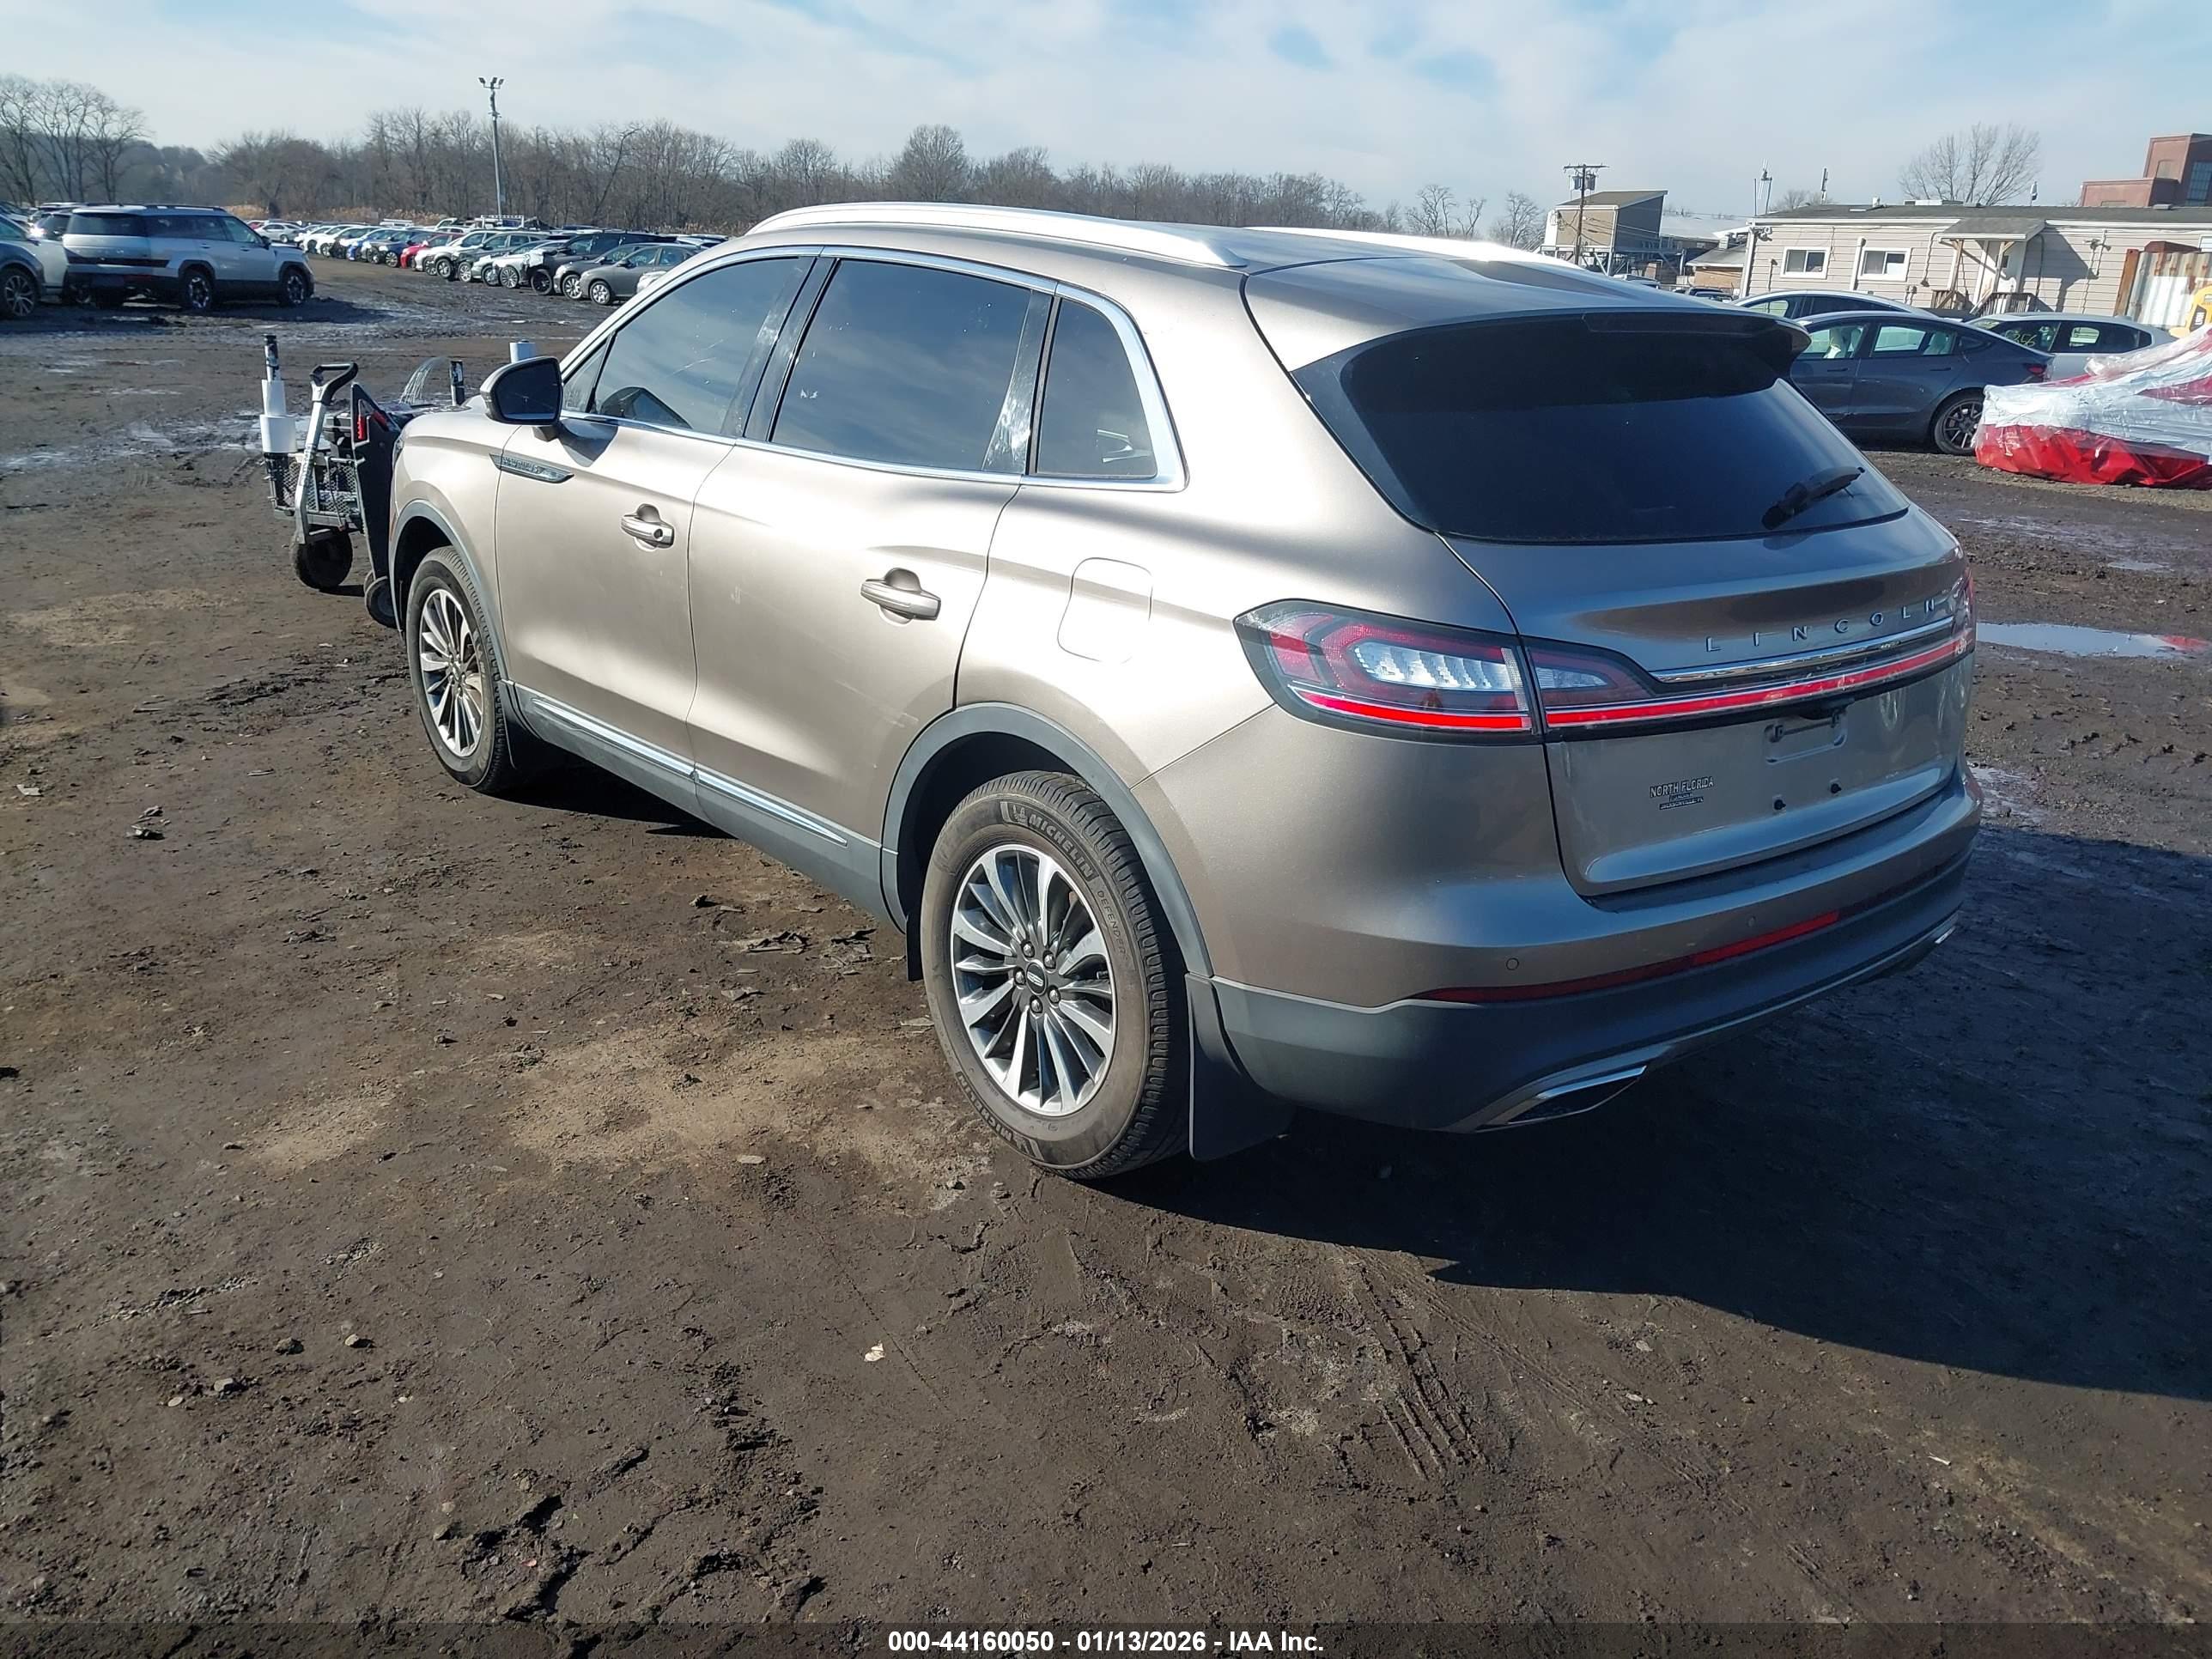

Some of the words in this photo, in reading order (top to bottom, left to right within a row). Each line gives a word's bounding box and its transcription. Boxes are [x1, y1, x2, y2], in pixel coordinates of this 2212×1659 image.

[1705, 599, 1935, 652] LINCOLN
[1649, 781, 1680, 799] NORTH
[1680, 775, 1715, 793] FLORIDA
[1028, 813, 1093, 878] MICHELIN
